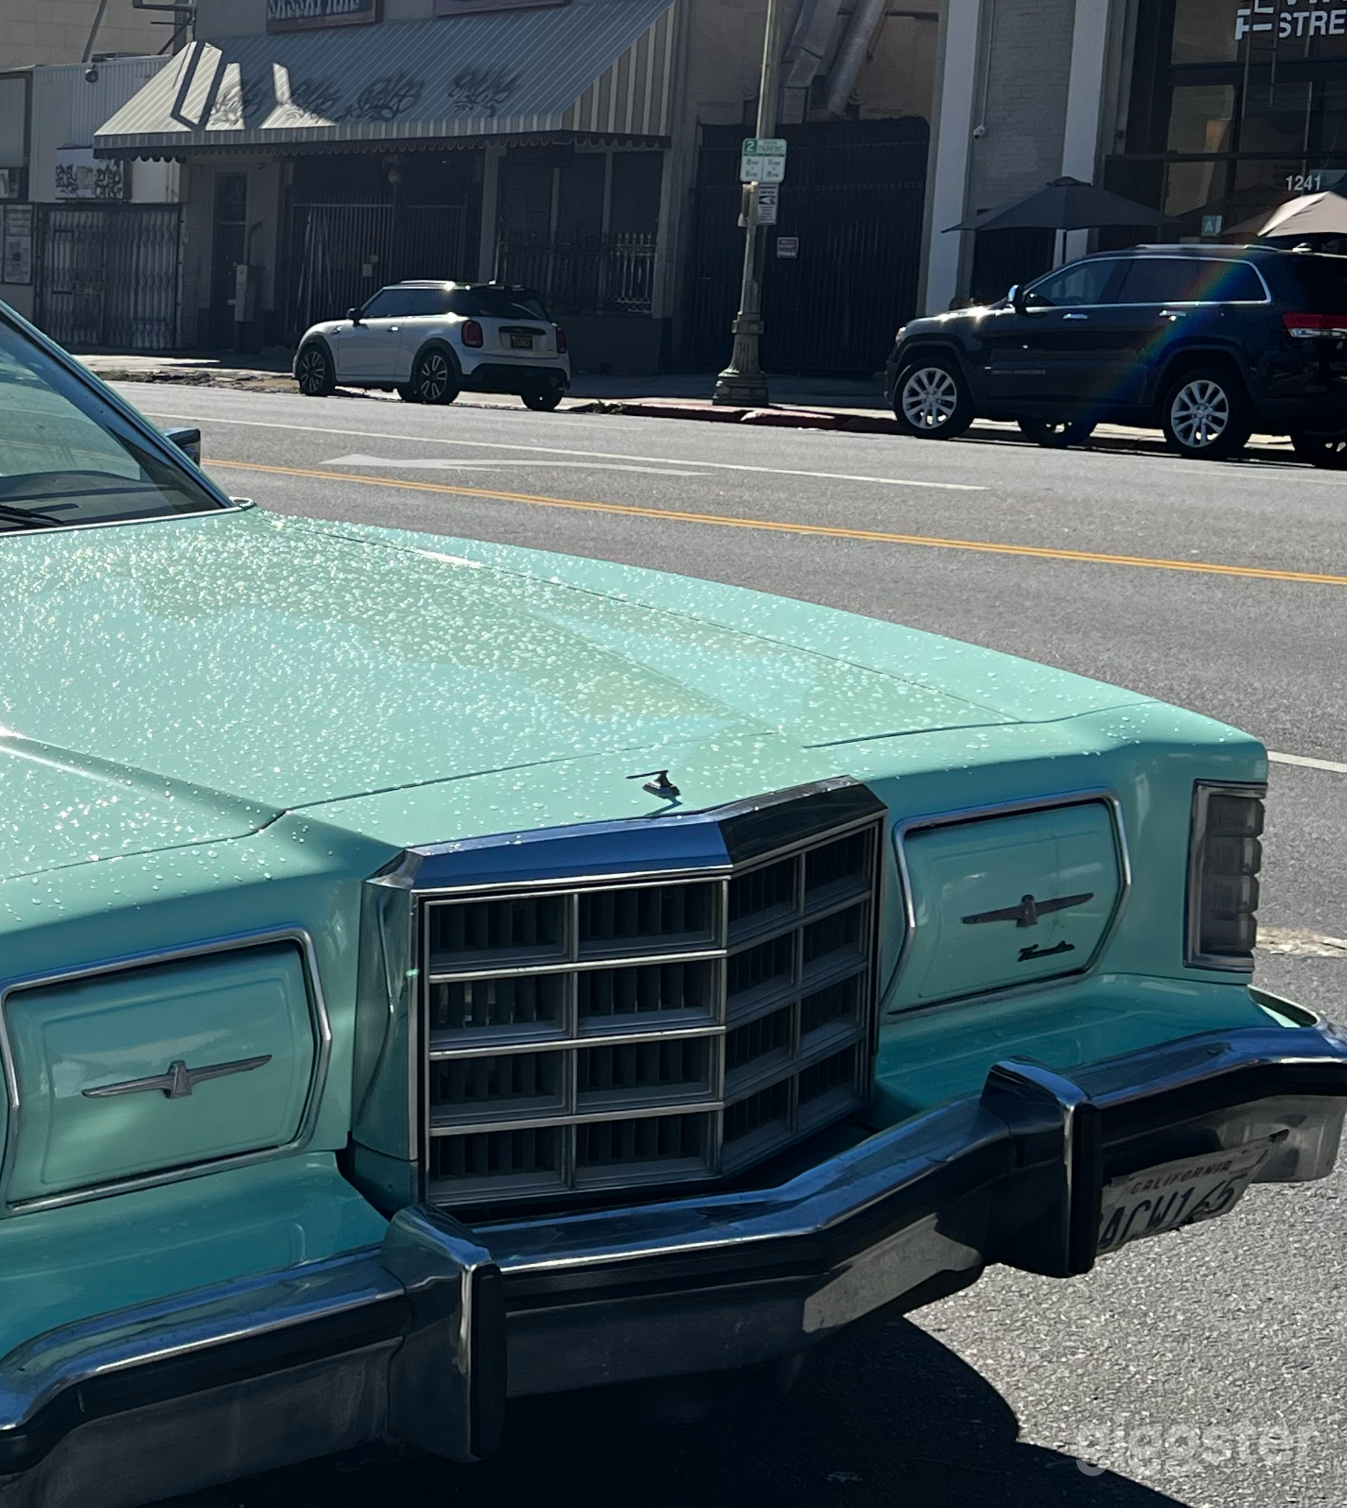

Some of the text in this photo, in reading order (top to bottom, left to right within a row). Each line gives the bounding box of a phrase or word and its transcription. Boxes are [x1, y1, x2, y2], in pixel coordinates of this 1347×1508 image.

[746, 141, 755, 152] 2
[1285, 174, 1322, 192] 1241
[1130, 1160, 1233, 1196] CALIFORNIA
